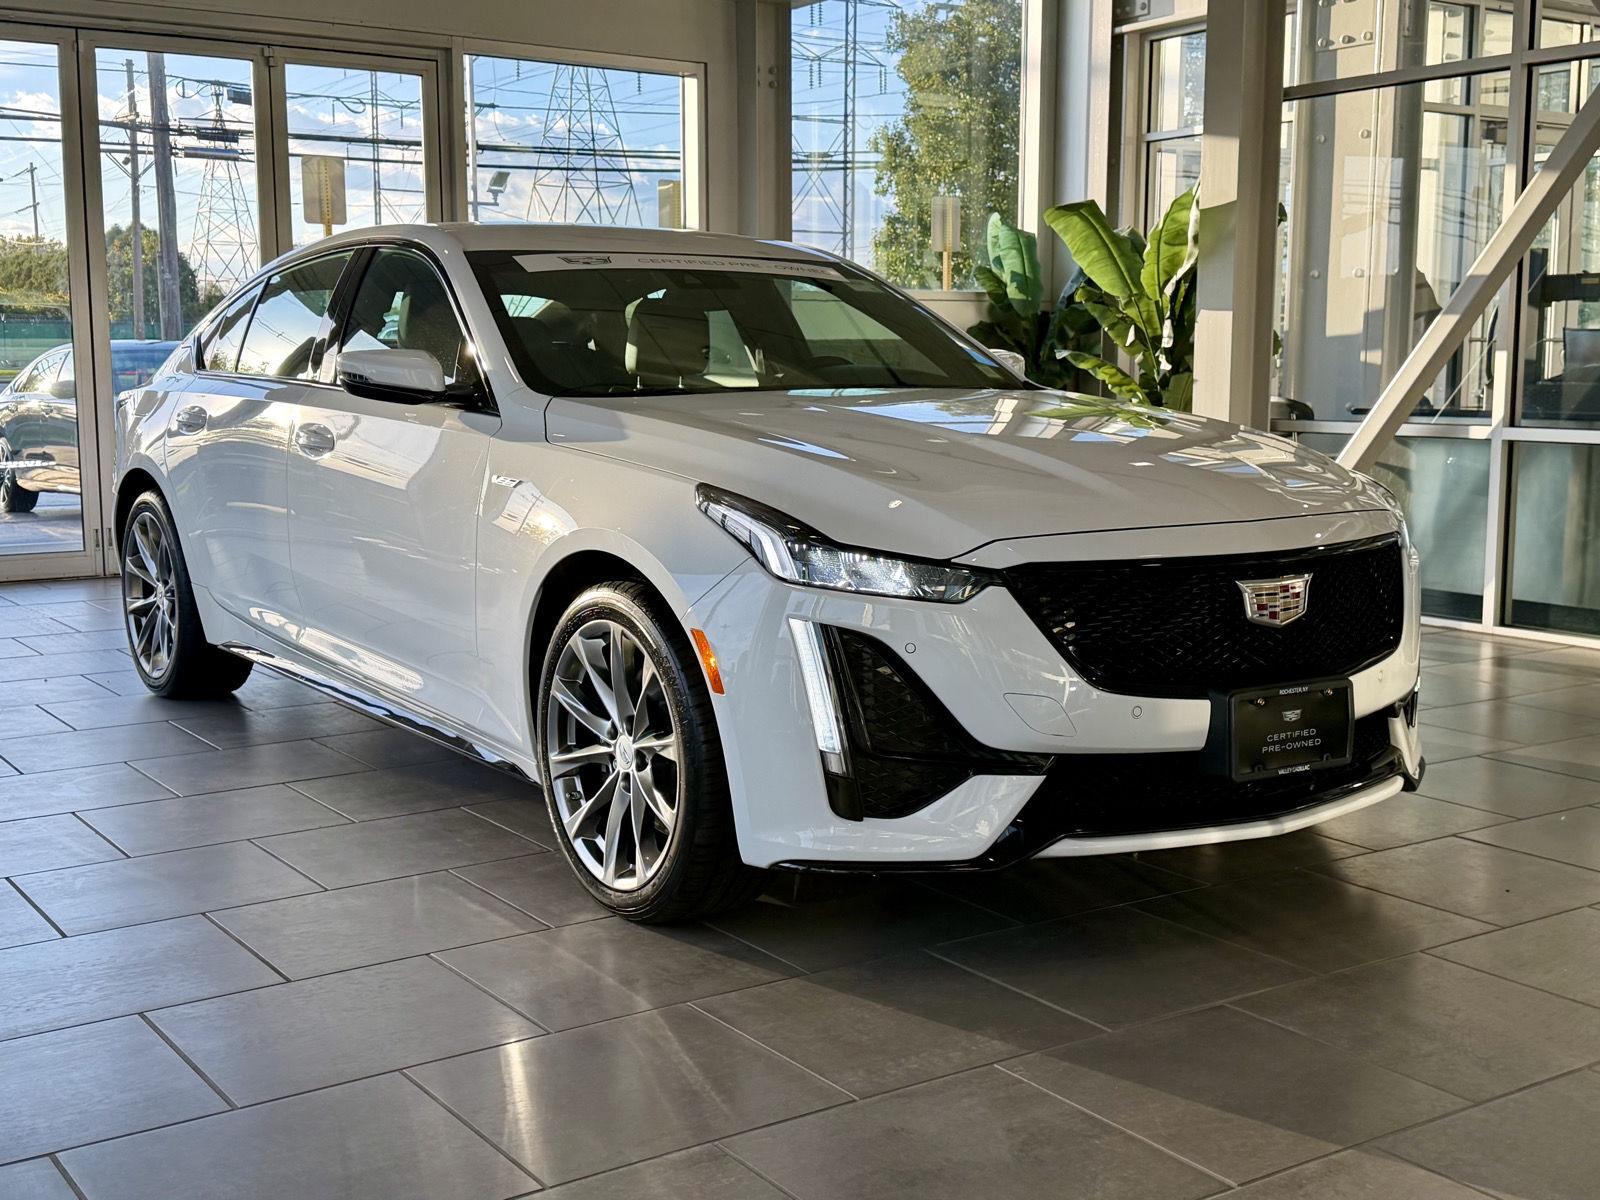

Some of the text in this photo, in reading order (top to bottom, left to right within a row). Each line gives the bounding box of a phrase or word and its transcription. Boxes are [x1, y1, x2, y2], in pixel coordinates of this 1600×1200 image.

[637, 257, 724, 266] CERTIFIED
[1266, 728, 1317, 742] CERTIFIED
[1262, 738, 1321, 754] PRE-OWNED
